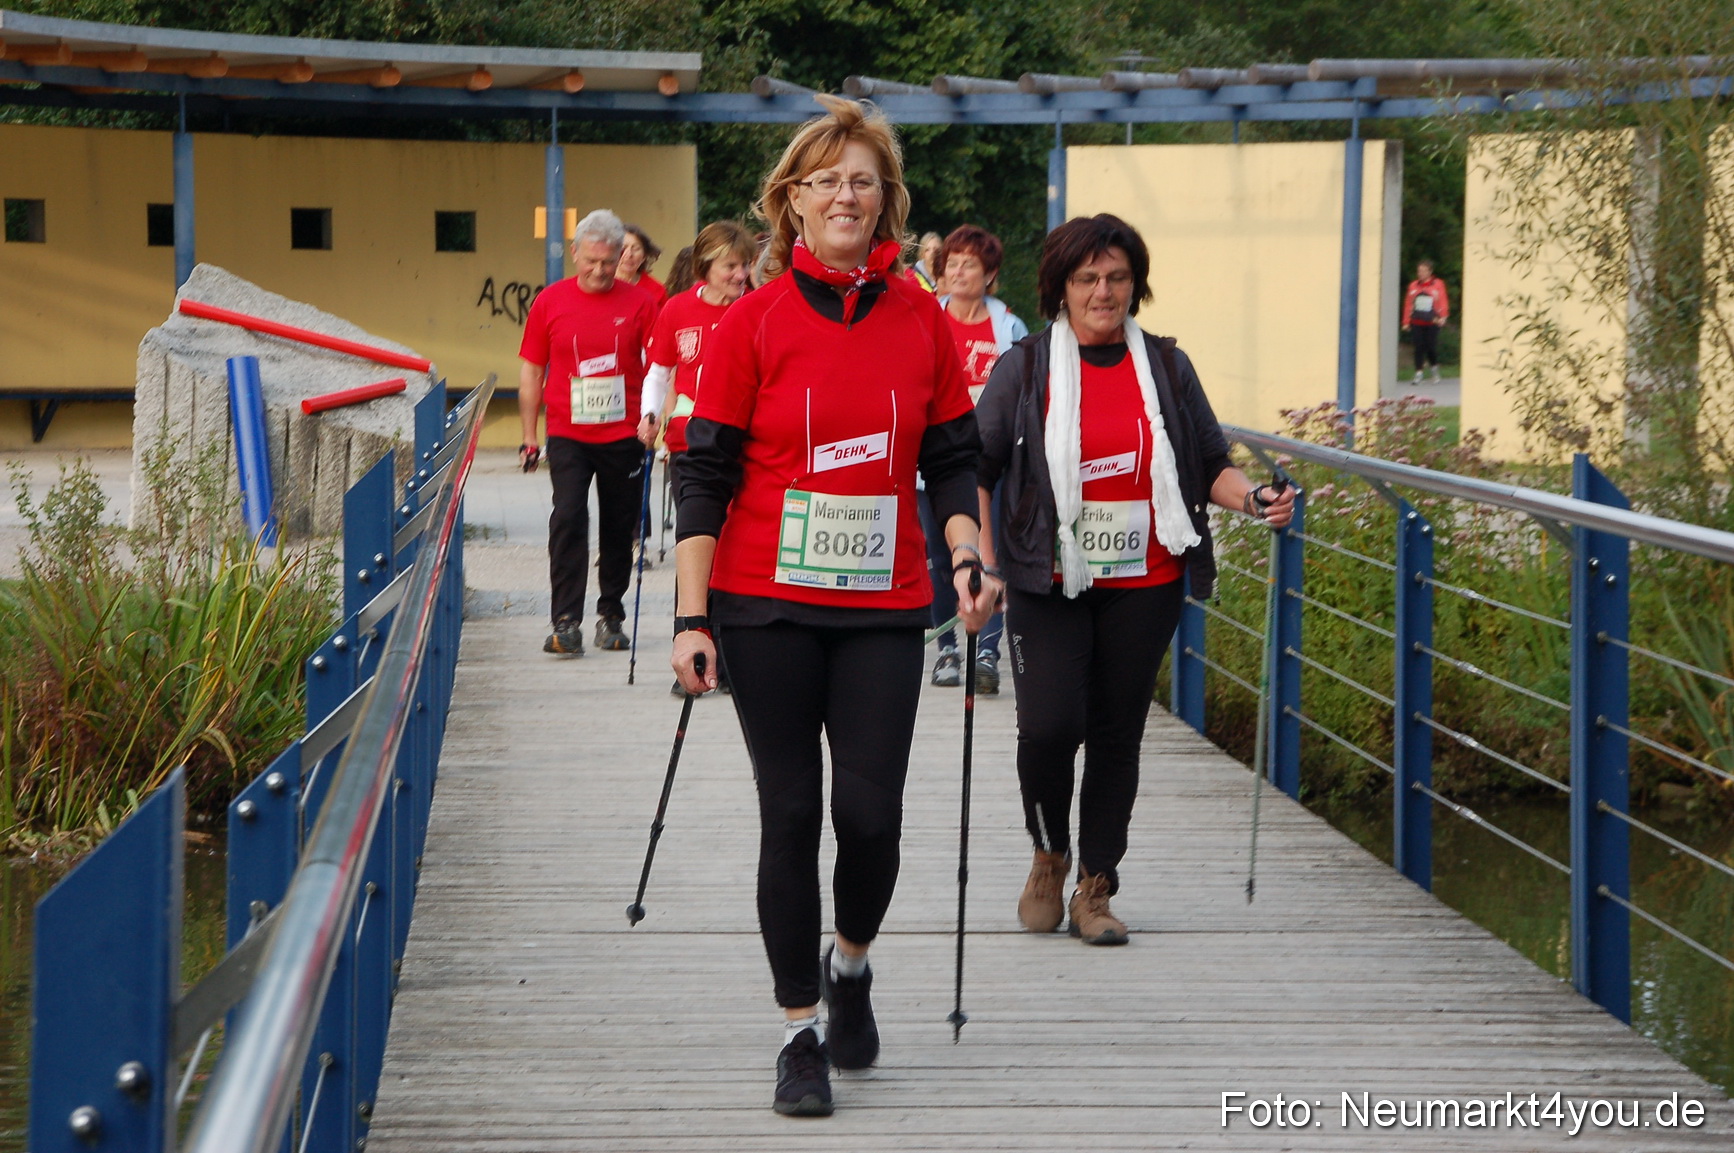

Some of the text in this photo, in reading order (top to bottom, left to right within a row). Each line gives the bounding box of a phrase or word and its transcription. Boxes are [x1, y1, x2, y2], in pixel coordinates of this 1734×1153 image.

[834, 443, 868, 460] DEHN
[1090, 461, 1119, 475] DEHN
[814, 501, 881, 520] Marianne
[1082, 506, 1113, 522] Erika
[813, 530, 886, 557] 8082
[1082, 530, 1141, 551] 8066
[849, 574, 890, 584] PFLEIDERER
